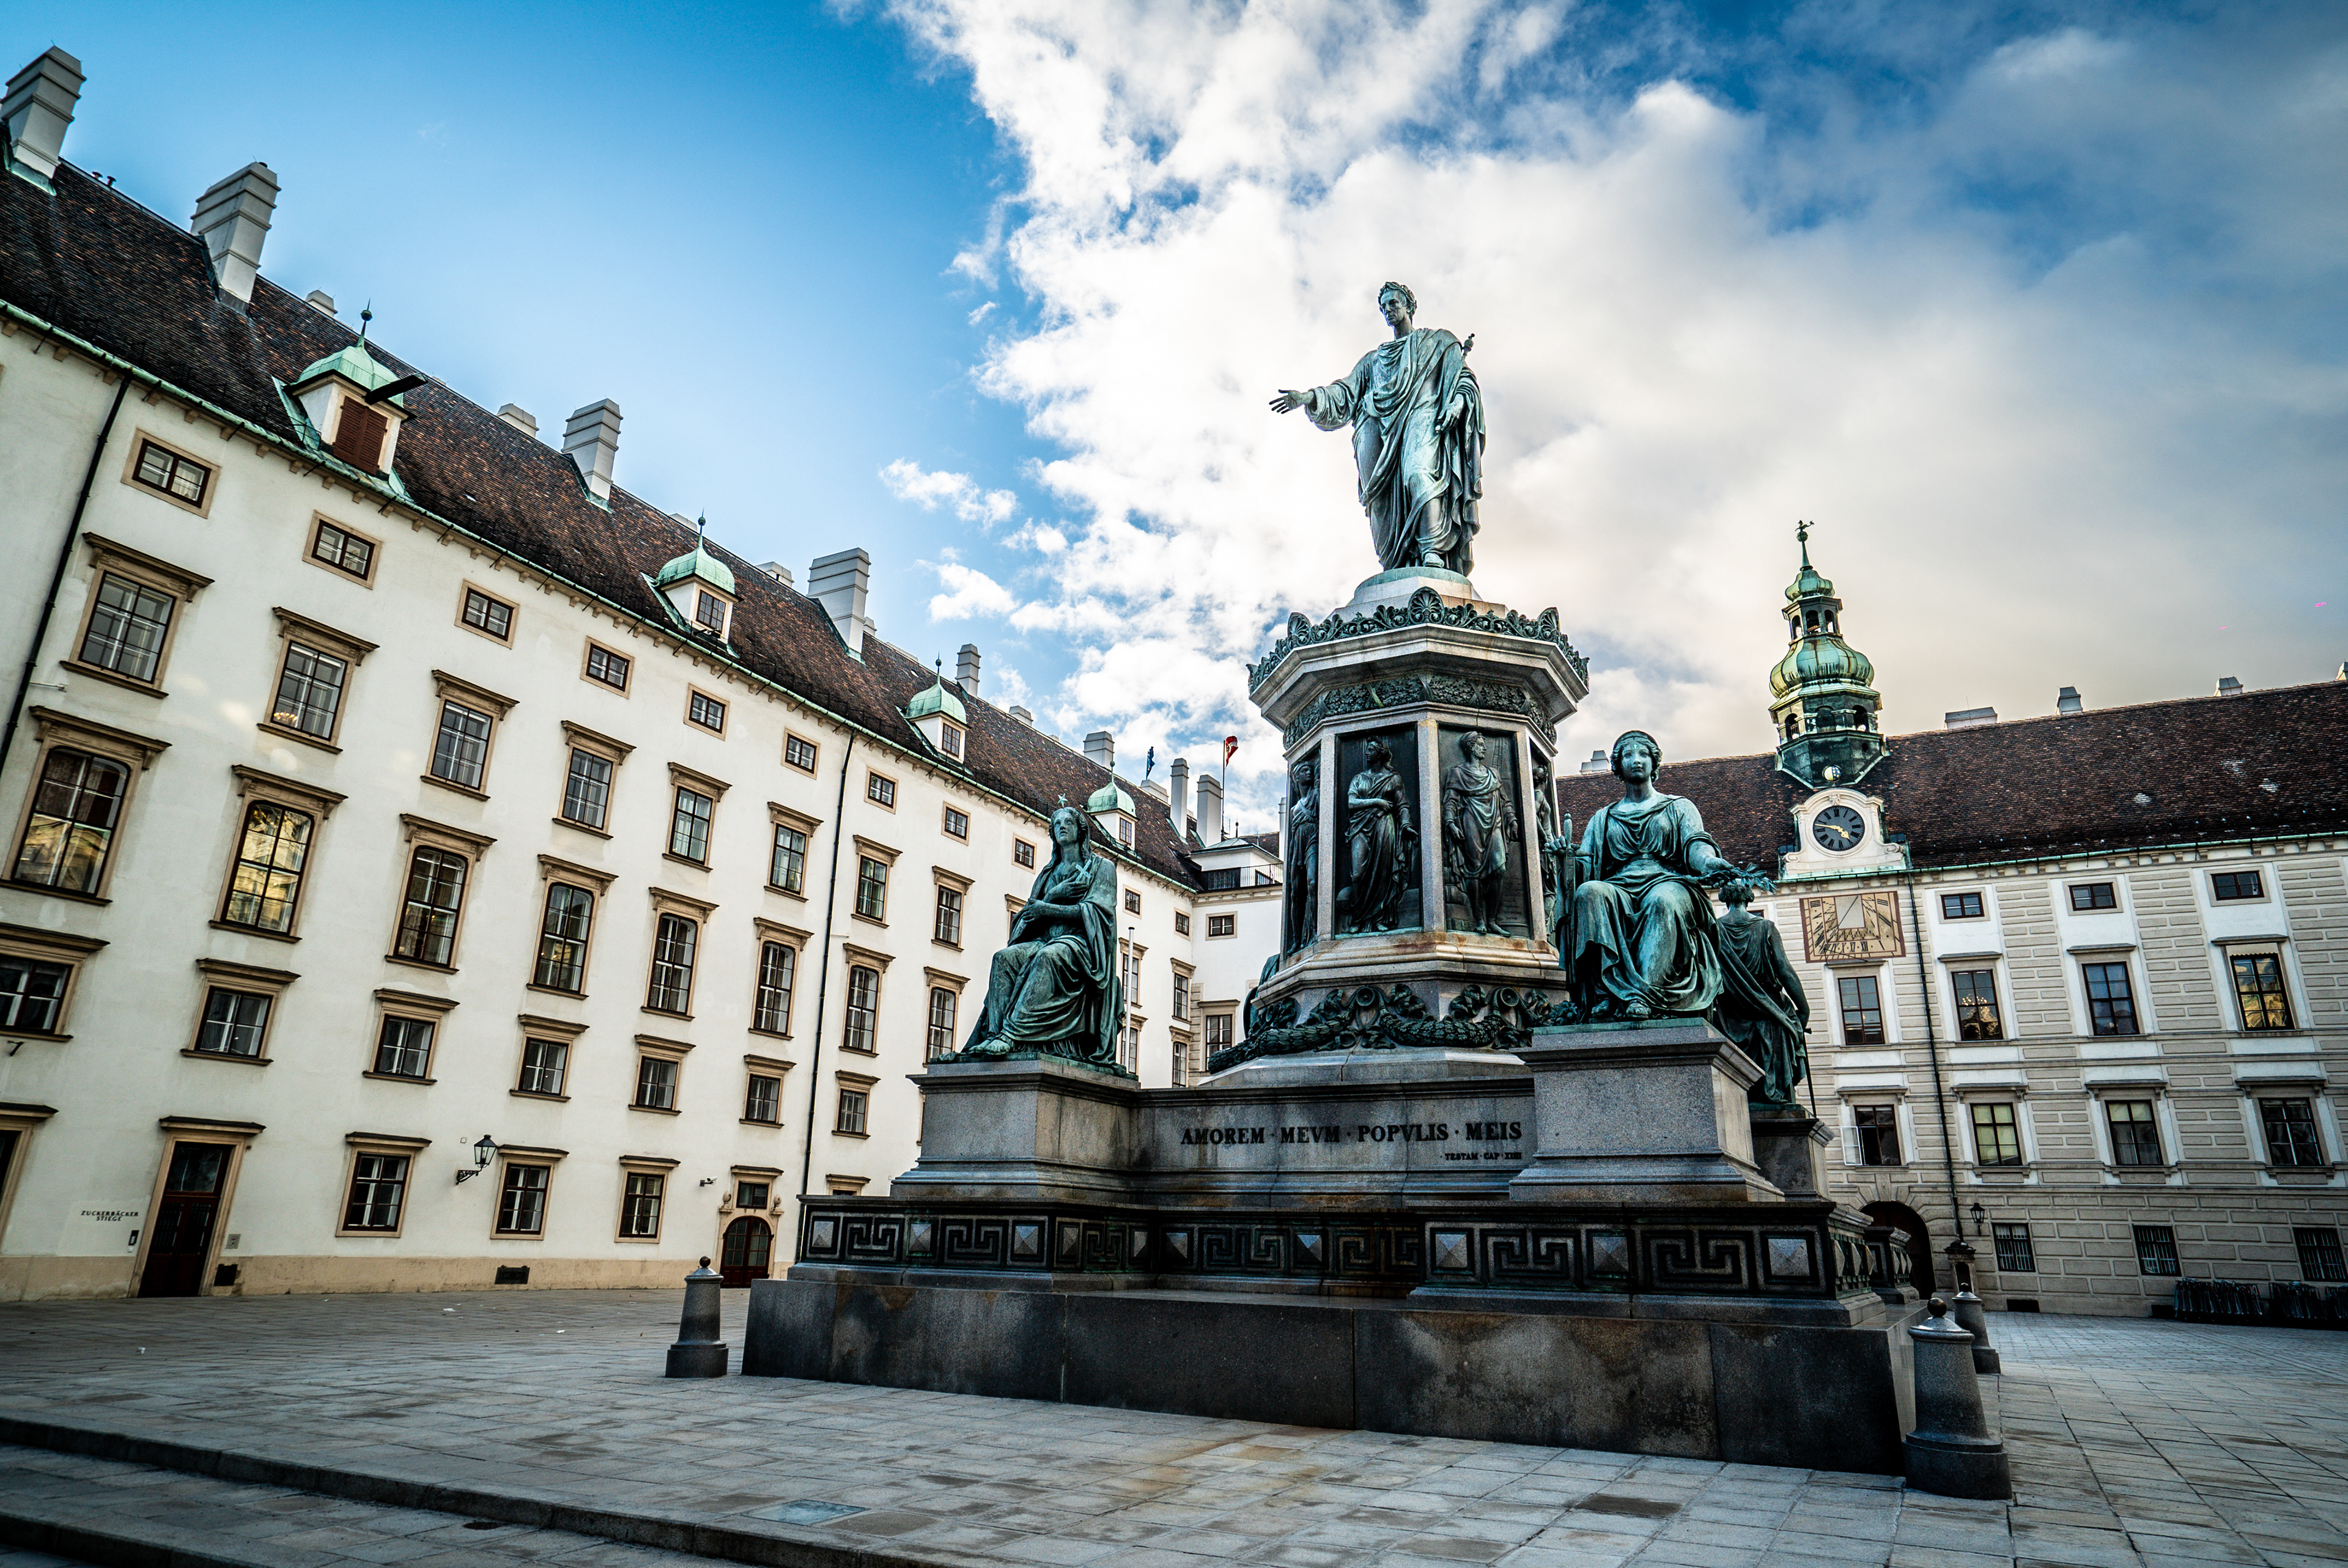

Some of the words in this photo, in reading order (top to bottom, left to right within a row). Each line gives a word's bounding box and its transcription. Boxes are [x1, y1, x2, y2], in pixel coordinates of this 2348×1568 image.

[1180, 1127, 1265, 1145] AMOREM
[1280, 1125, 1342, 1144] MEVM
[1357, 1123, 1449, 1143] POPVLIS
[1465, 1121, 1523, 1141] MEIS
[1483, 1152, 1500, 1160] CAP
